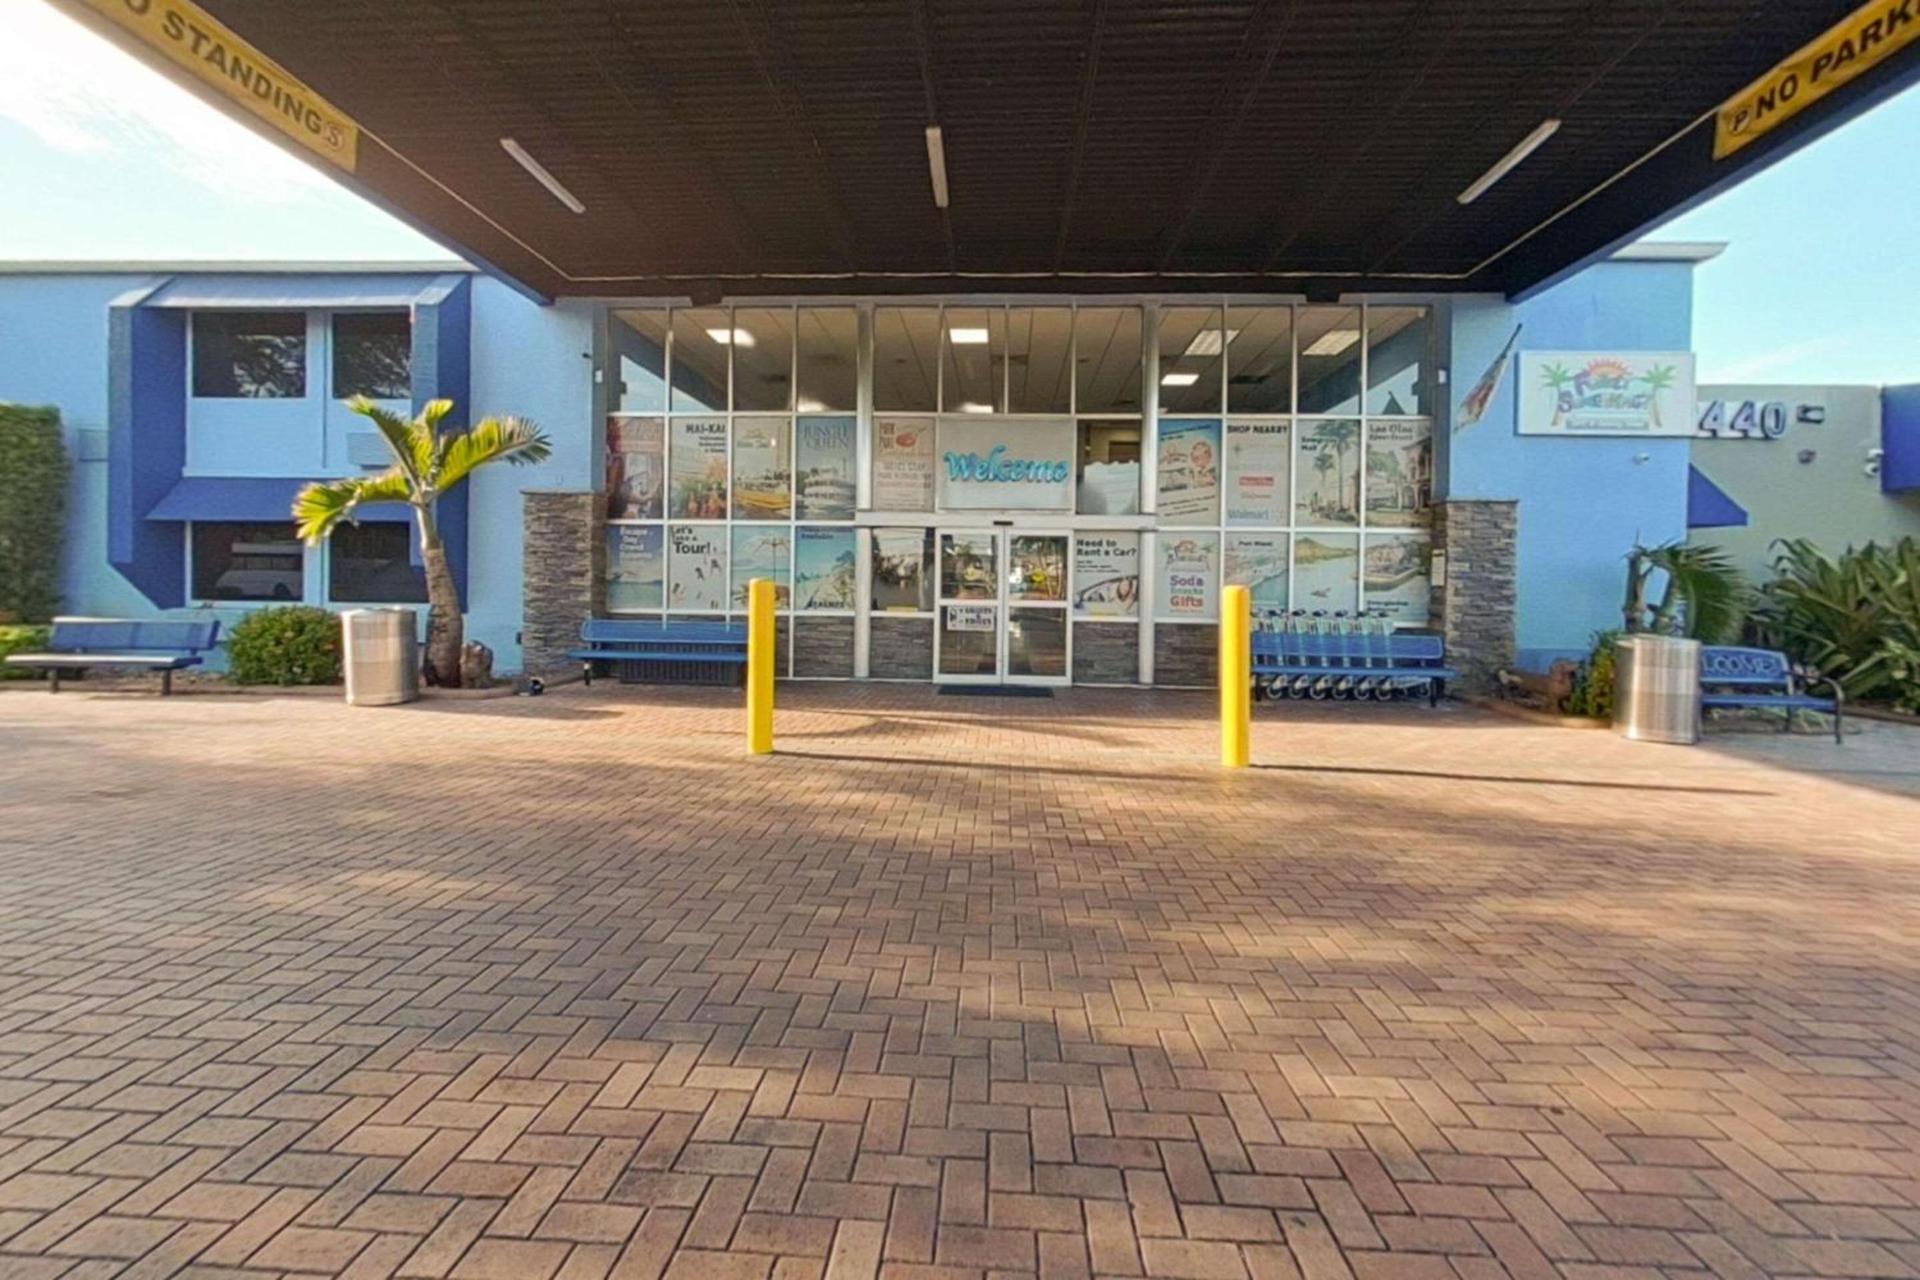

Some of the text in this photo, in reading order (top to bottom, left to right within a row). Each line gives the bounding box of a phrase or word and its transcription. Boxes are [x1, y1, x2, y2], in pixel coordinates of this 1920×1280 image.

[1756, 73, 1799, 119] NO
[1810, 0, 1920, 83] PARK
[162, 9, 323, 134] STANDING
[1698, 400, 1787, 440] 440
[1227, 425, 1250, 434] SHOP
[943, 443, 1068, 483] Welcome
[673, 541, 711, 554] Tour!
[1077, 539, 1117, 547] Need to
[1113, 547, 1137, 558] Car?
[1170, 575, 1204, 586] Soda
[1170, 595, 1204, 608] Gifts
